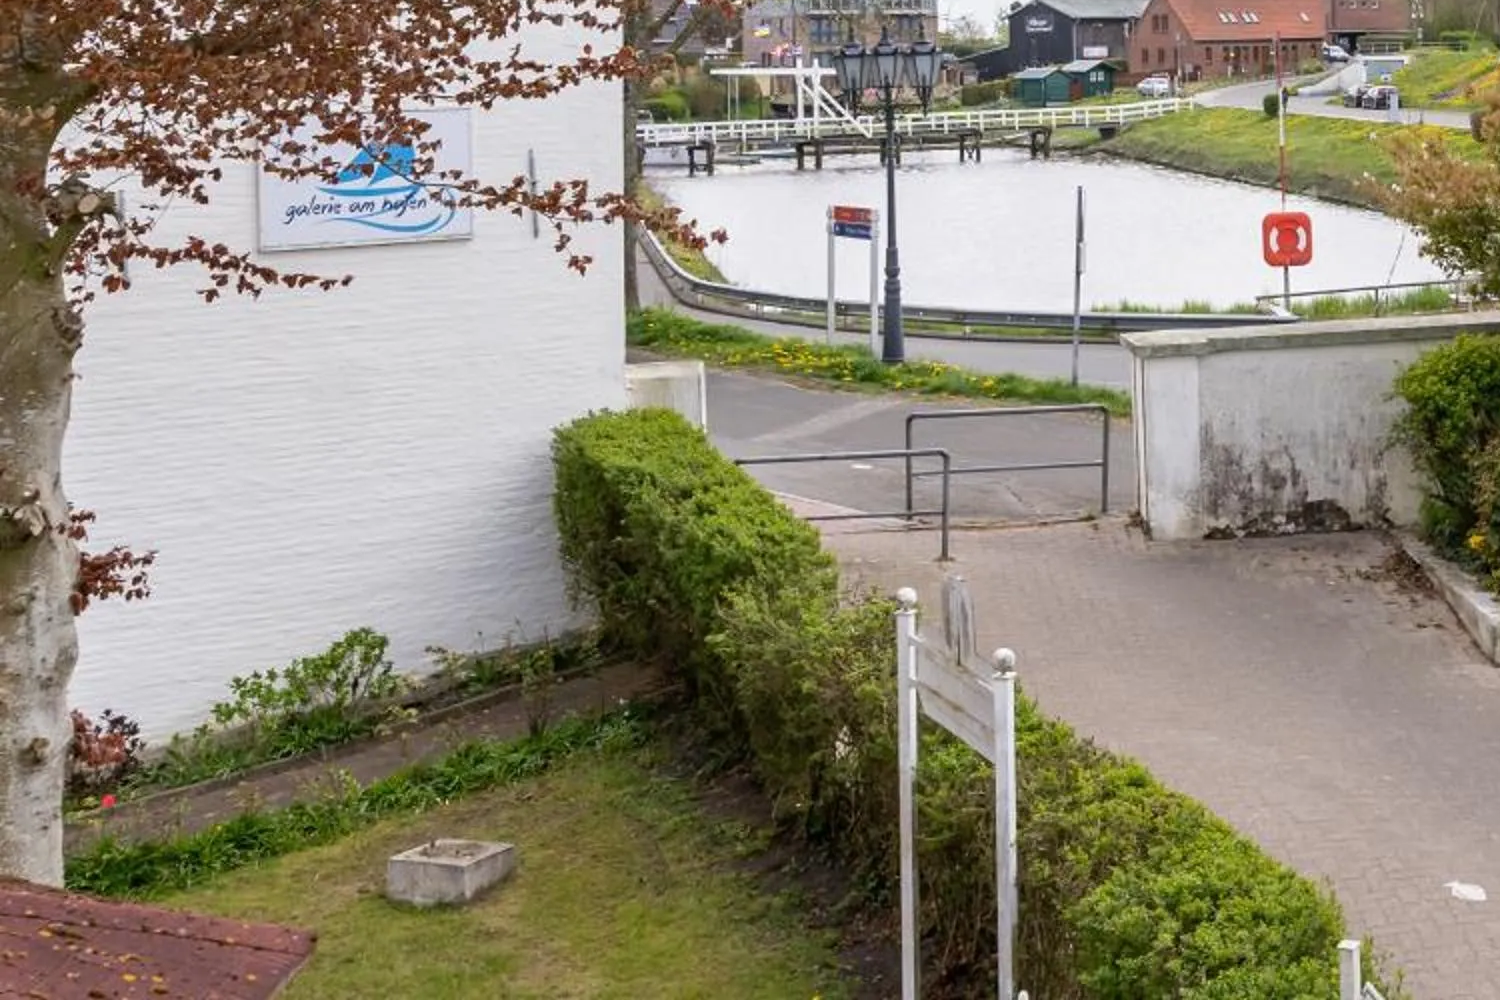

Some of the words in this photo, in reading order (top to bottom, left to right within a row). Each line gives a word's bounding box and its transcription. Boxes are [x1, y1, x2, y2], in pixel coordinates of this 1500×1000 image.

[283, 195, 341, 224] galerie
[348, 199, 375, 213] am
[382, 191, 427, 217] hafen
